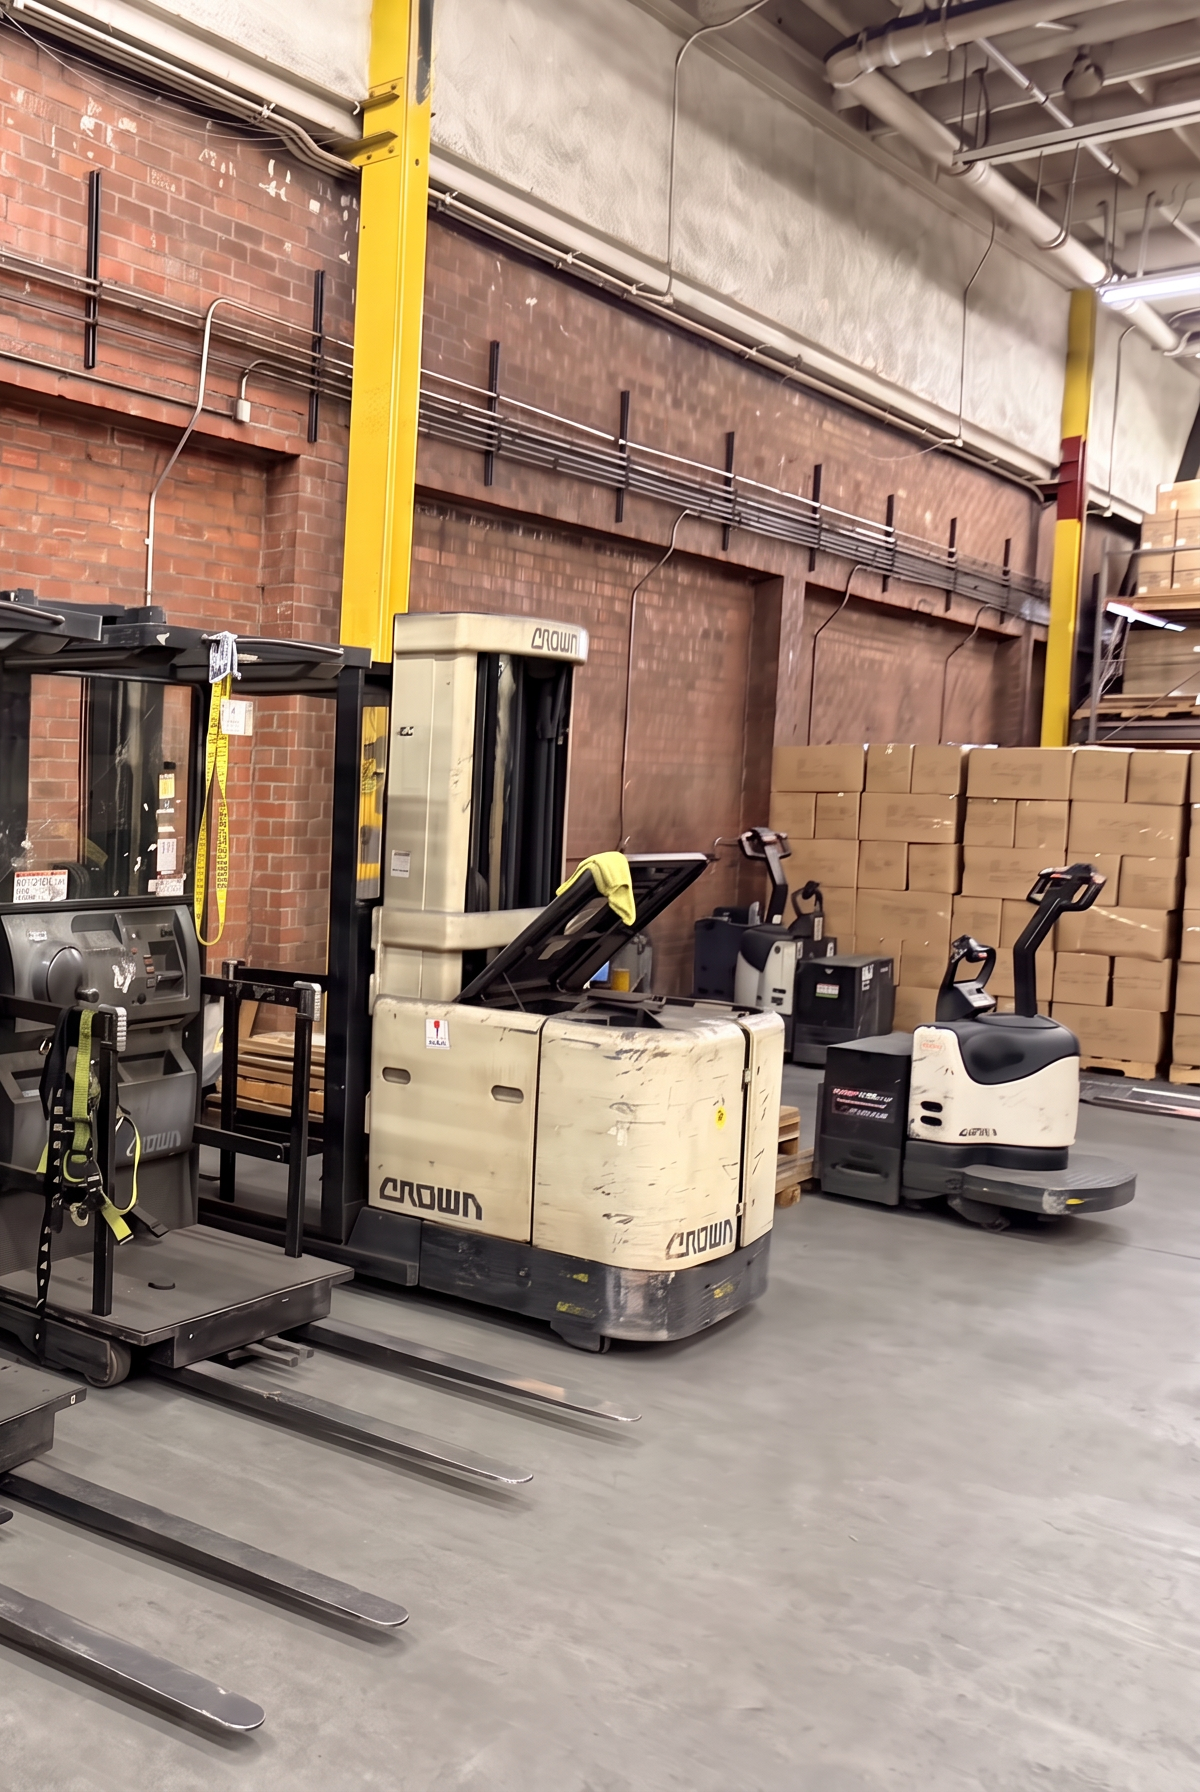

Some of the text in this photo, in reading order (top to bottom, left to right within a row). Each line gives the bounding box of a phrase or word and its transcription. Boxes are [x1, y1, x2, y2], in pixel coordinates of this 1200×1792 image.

[531, 627, 577, 655] CROWN
[379, 1176, 482, 1221] CROWN
[665, 1218, 733, 1260] CROWN
